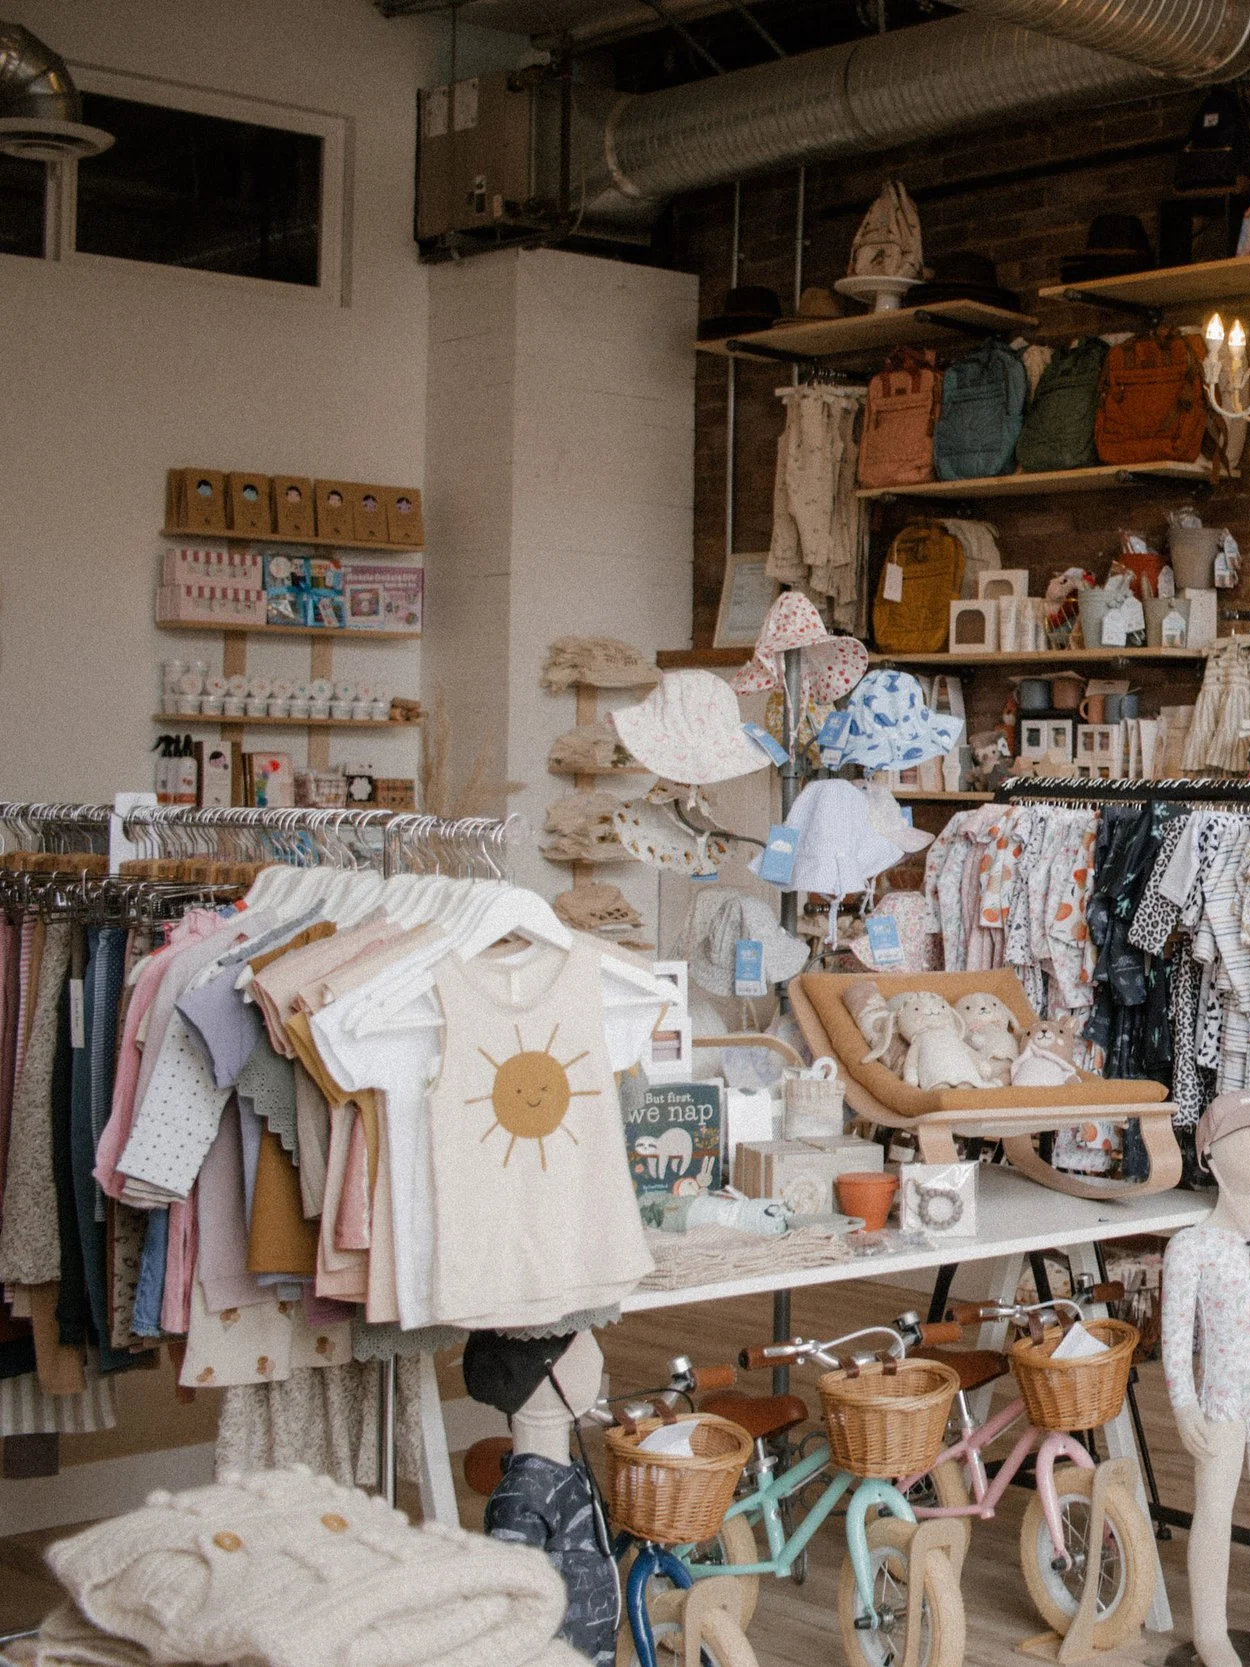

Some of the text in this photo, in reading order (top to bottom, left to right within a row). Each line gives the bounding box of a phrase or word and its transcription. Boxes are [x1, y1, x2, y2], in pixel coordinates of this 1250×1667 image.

[645, 1092, 665, 1104] But
[629, 1103, 714, 1126] we nap
